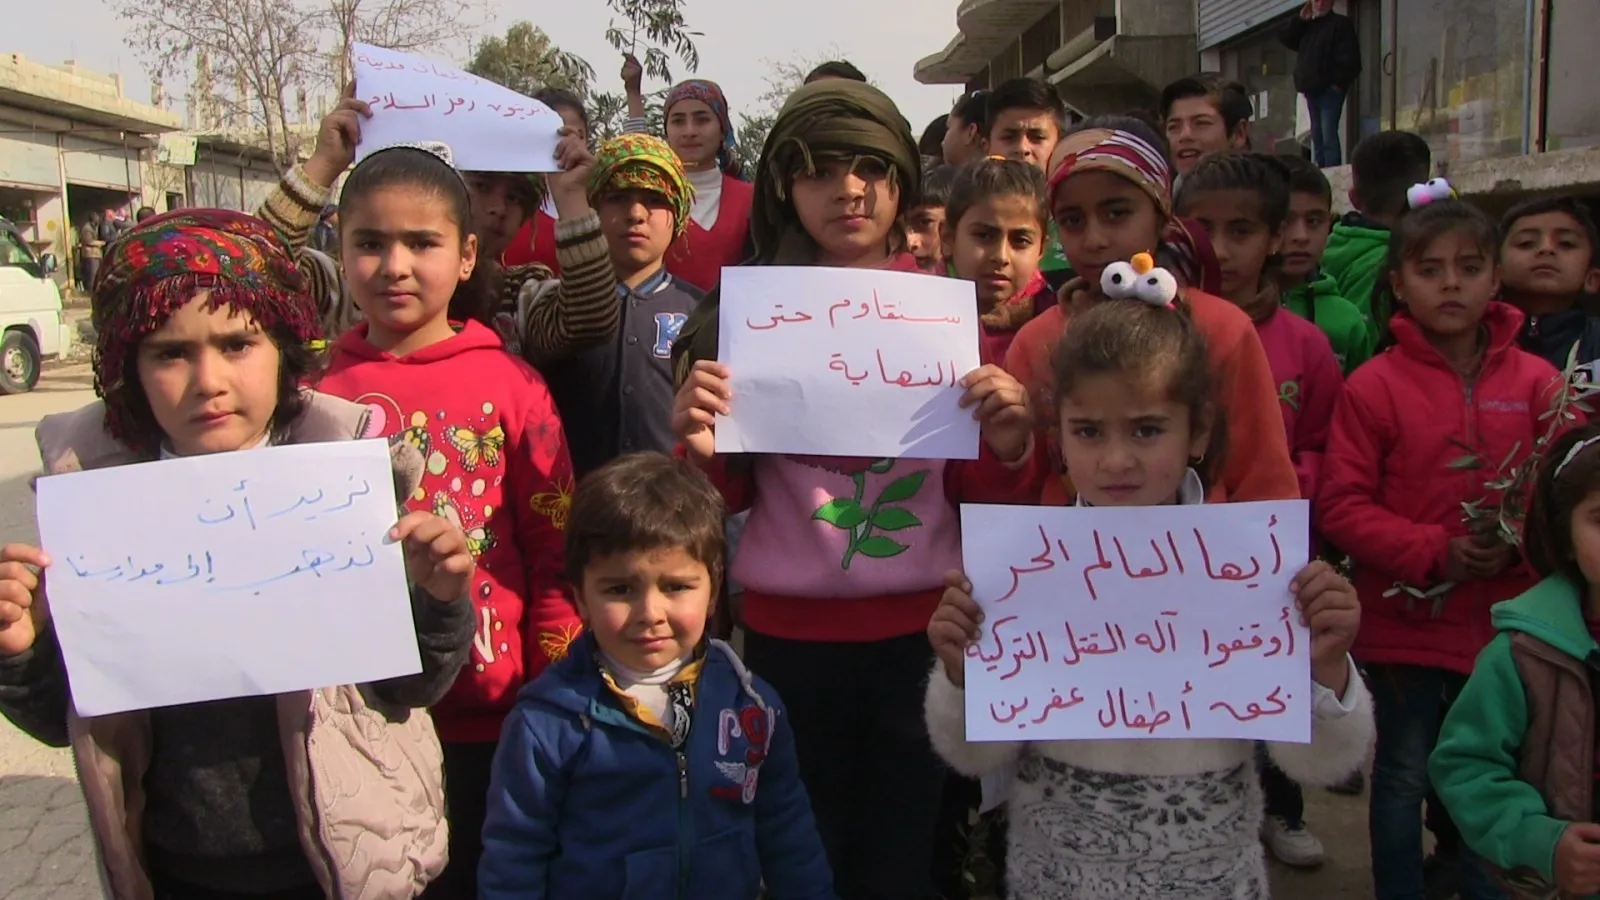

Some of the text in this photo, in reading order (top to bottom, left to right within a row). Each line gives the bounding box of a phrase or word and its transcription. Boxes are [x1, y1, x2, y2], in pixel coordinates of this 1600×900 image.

[367, 92, 436, 111] السلام
[443, 92, 475, 115] رمز
[746, 287, 961, 330] سنقاوم حتى
[829, 348, 955, 388] النهاية
[197, 479, 257, 530] أن
[994, 514, 1282, 602] أيها العالم الحر
[1063, 620, 1127, 666] القتل
[1202, 606, 1295, 669] أوقفوا
[989, 687, 1085, 730] عفرين
[1098, 681, 1194, 734] أطفال
